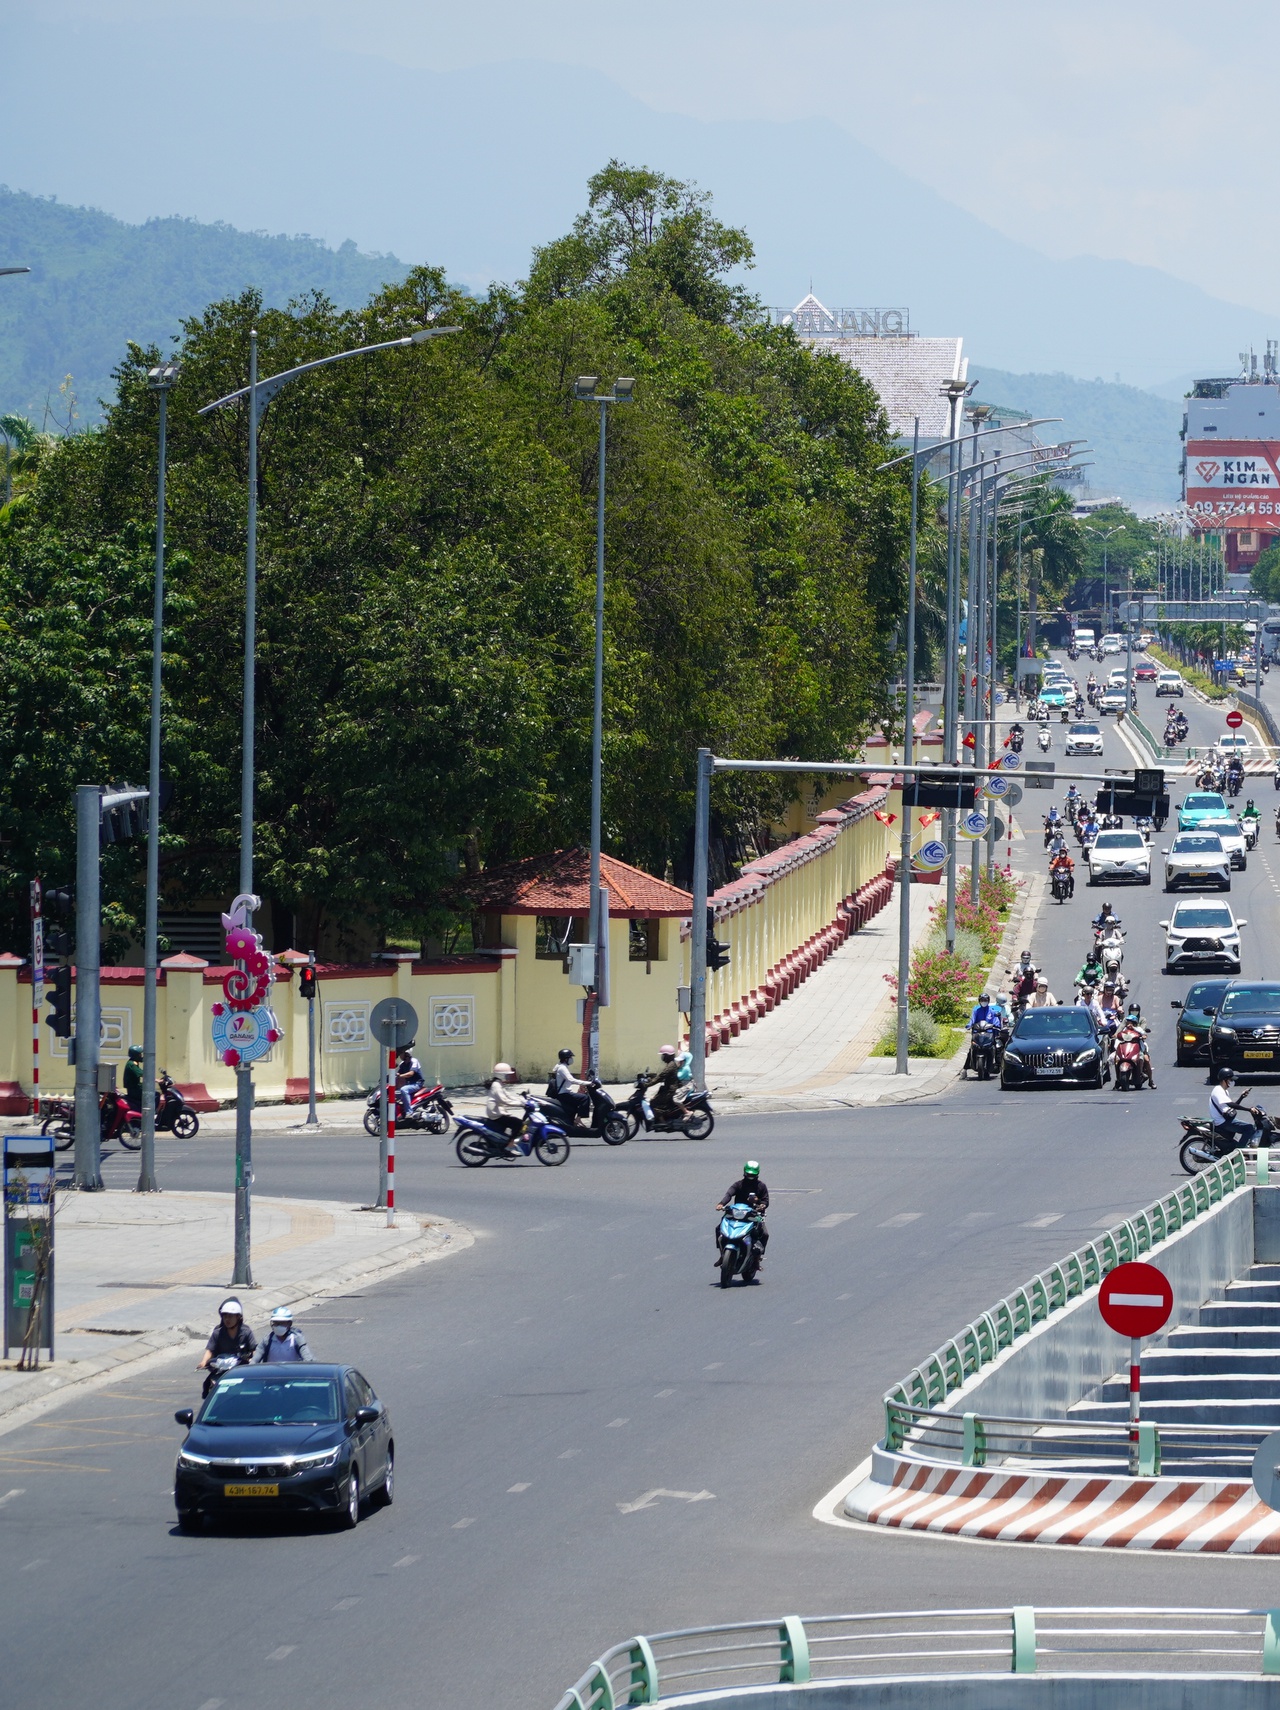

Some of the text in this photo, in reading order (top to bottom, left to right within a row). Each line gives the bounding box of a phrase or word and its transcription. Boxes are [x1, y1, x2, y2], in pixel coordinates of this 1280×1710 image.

[777, 310, 903, 334] DANANG
[1223, 461, 1256, 472] KIM
[1223, 473, 1270, 484] NGAN
[1194, 501, 1214, 515] 09
[1216, 501, 1236, 515] 77
[1258, 501, 1274, 515] 55
